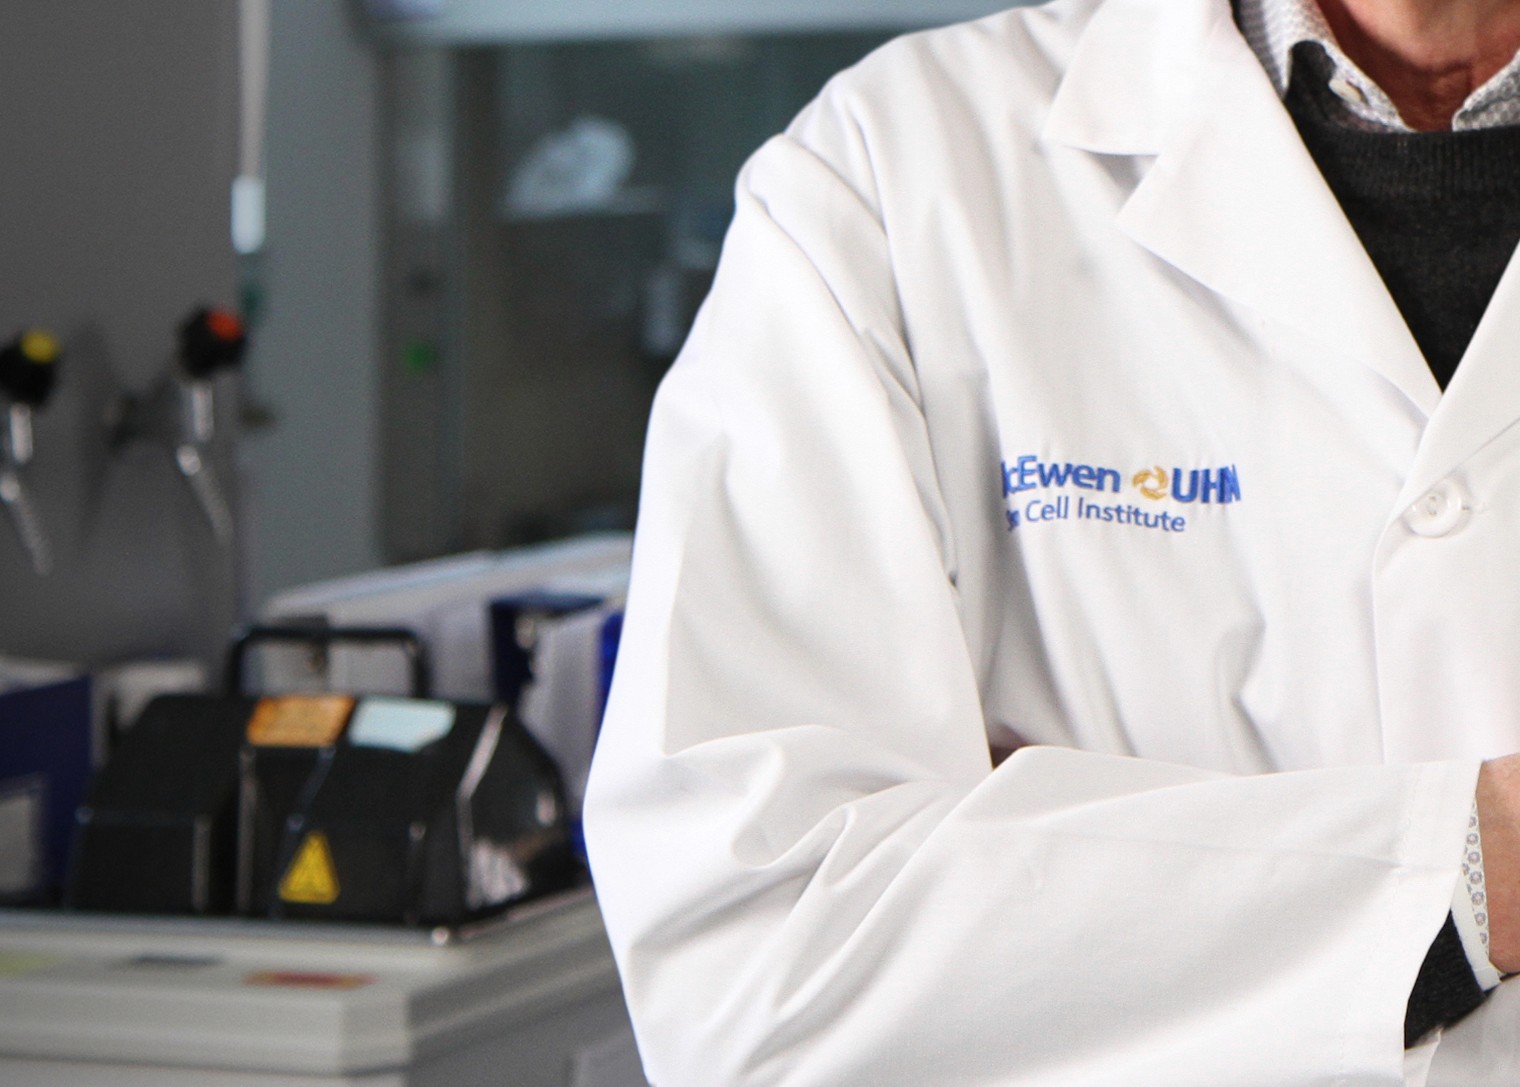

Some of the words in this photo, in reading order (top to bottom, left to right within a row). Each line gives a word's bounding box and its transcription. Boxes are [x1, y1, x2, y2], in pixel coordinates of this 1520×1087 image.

[1171, 464, 1241, 504] UHN
[1026, 496, 1069, 522] Cell
[1078, 497, 1186, 532] Institute
